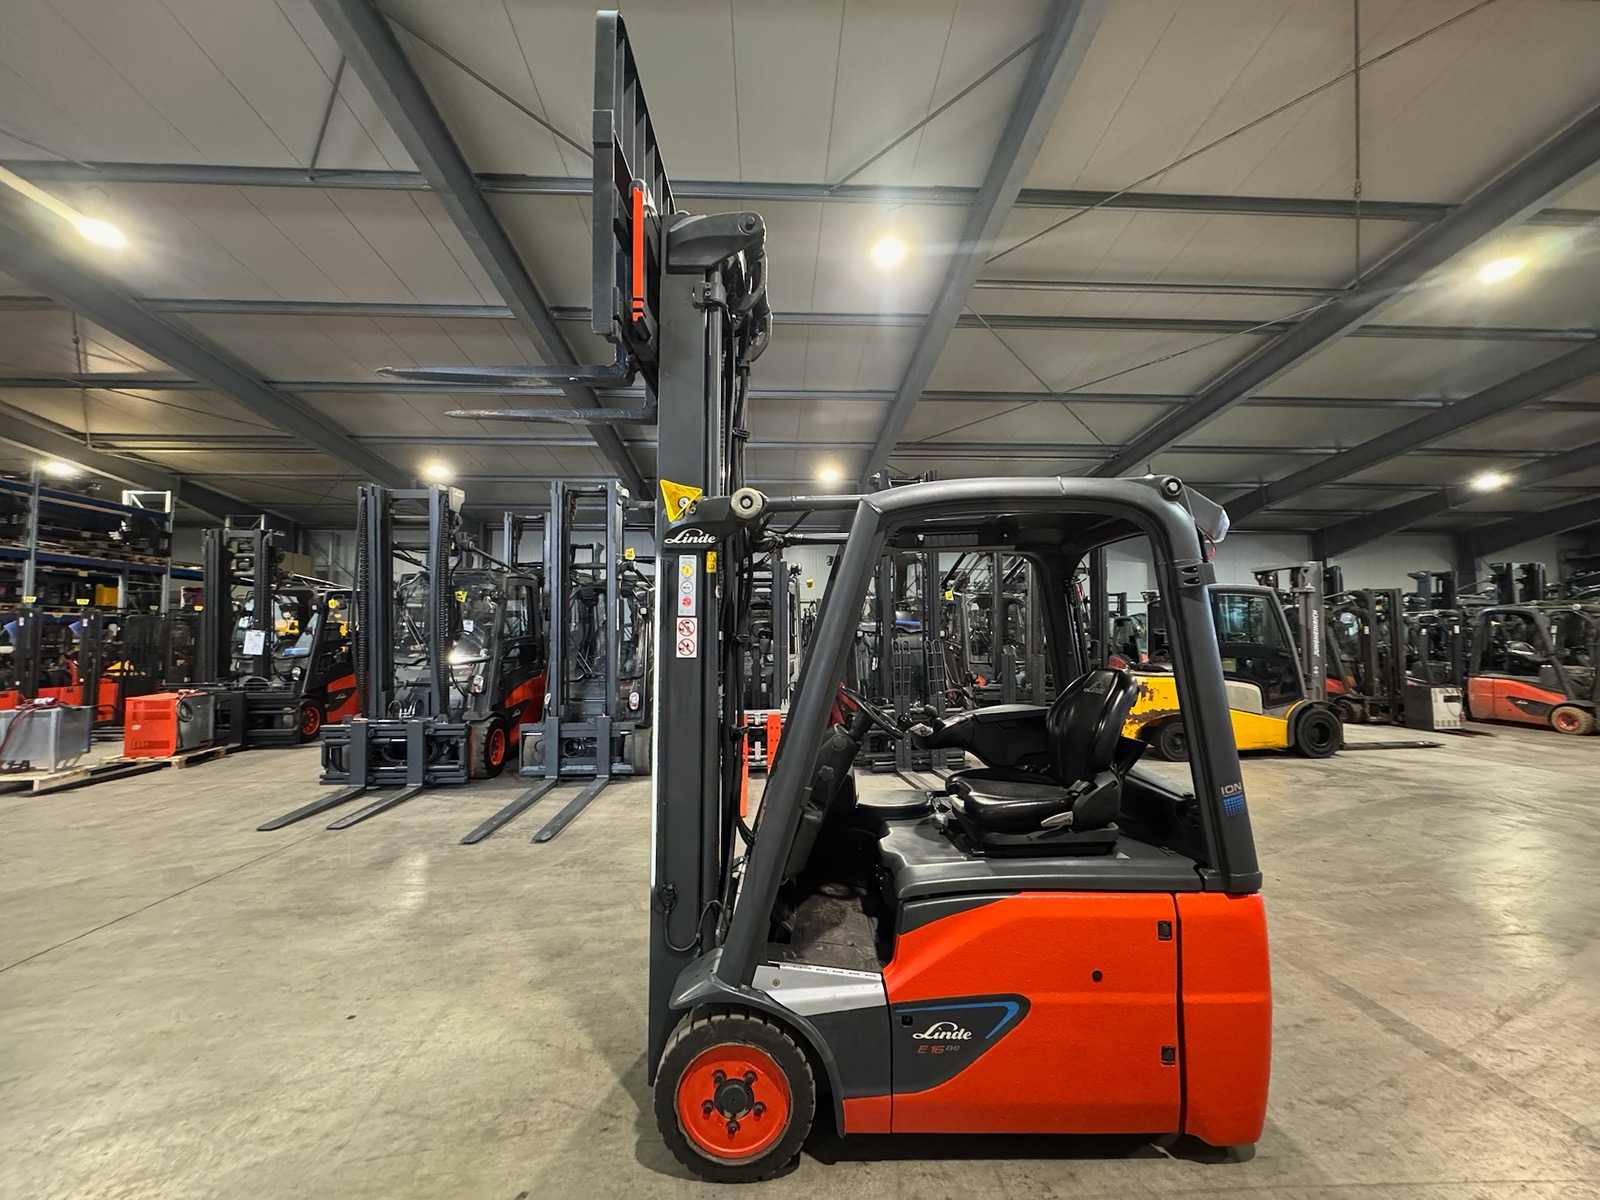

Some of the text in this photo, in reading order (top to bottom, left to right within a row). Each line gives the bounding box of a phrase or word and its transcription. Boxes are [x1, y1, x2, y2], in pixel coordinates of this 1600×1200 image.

[664, 528, 716, 543] Linde
[1220, 782, 1243, 795] ION
[912, 1021, 973, 1041] Linde
